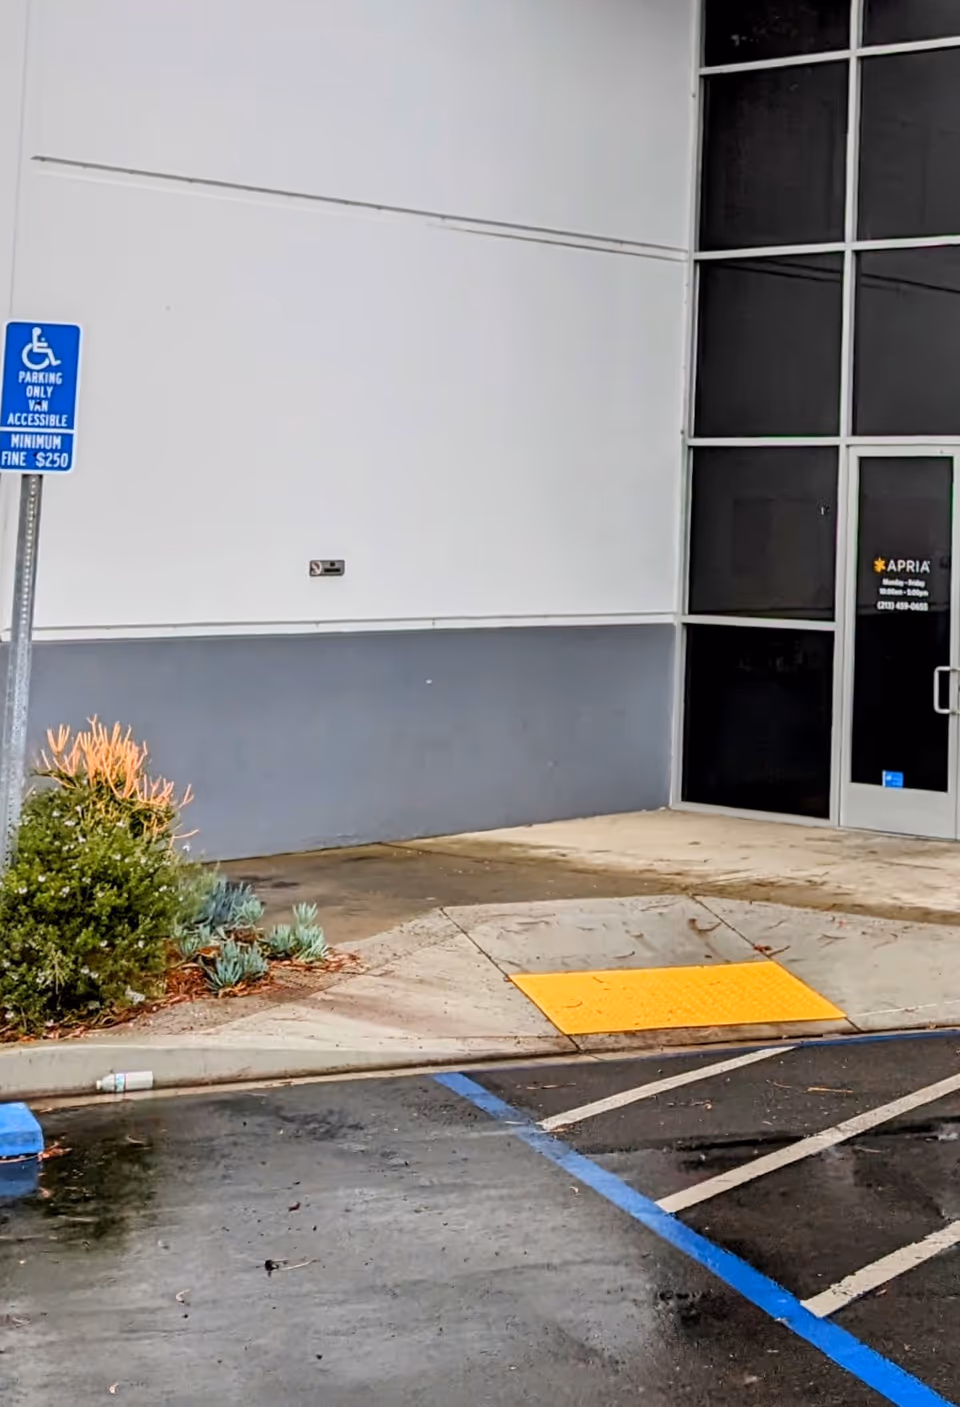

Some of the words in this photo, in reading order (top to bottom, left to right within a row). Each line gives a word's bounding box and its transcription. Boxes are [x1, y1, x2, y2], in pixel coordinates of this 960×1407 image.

[18, 370, 63, 385] PARKING
[26, 385, 54, 398] ONLY
[28, 399, 48, 412] VAN
[7, 413, 68, 427] ACCESSIBLE
[11, 434, 62, 450] MINIMUM
[1, 451, 27, 467] FINE
[35, 452, 69, 468] $250
[887, 559, 930, 573] APRIA
